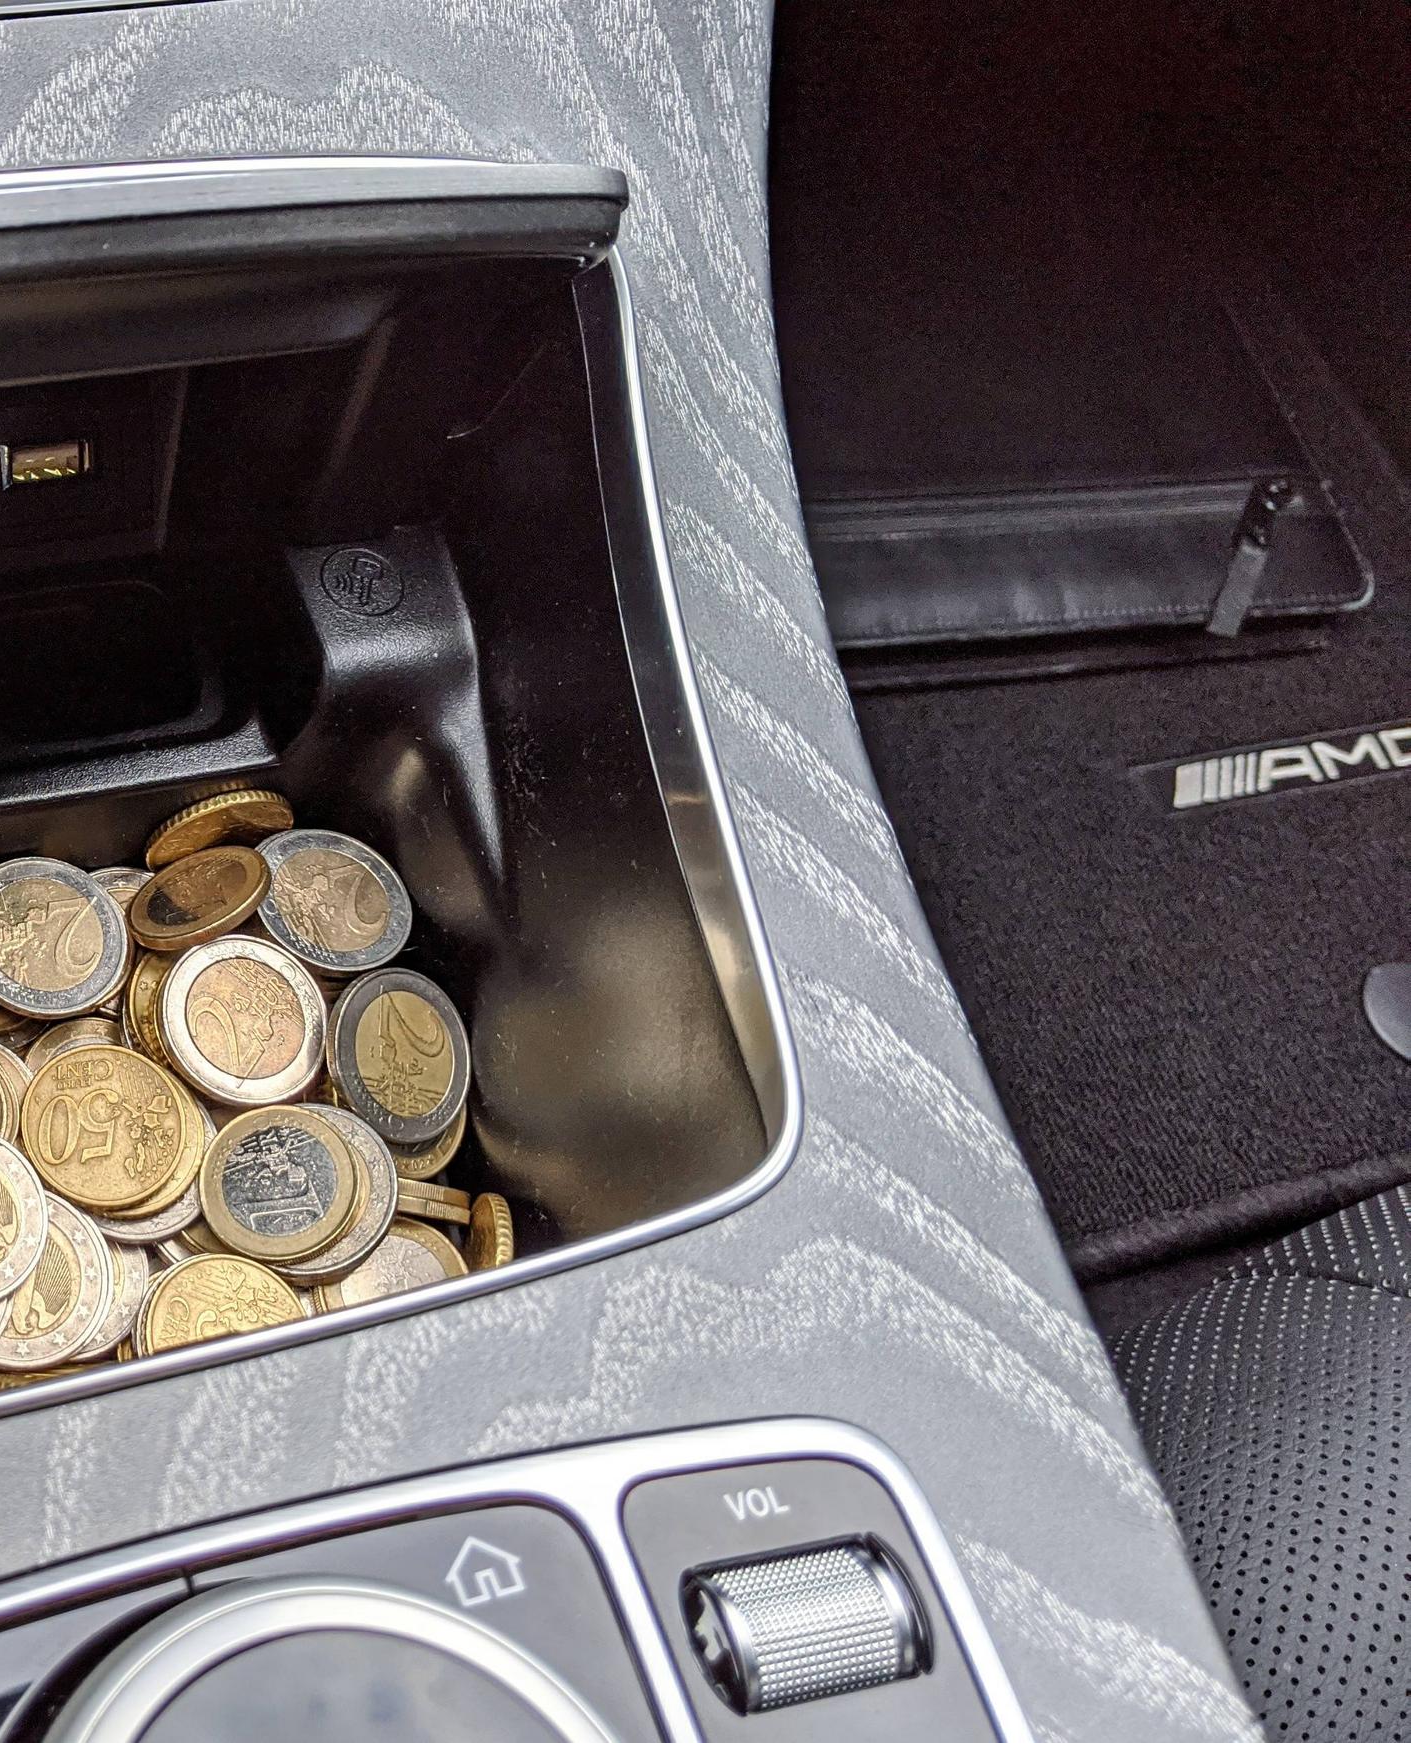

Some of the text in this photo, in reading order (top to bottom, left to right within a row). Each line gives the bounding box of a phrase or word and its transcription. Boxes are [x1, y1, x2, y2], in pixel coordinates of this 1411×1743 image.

[53, 1058, 114, 1079] CENT
[186, 994, 266, 1088] 2
[37, 1087, 121, 1165] 50
[723, 1486, 789, 1520] VOL
